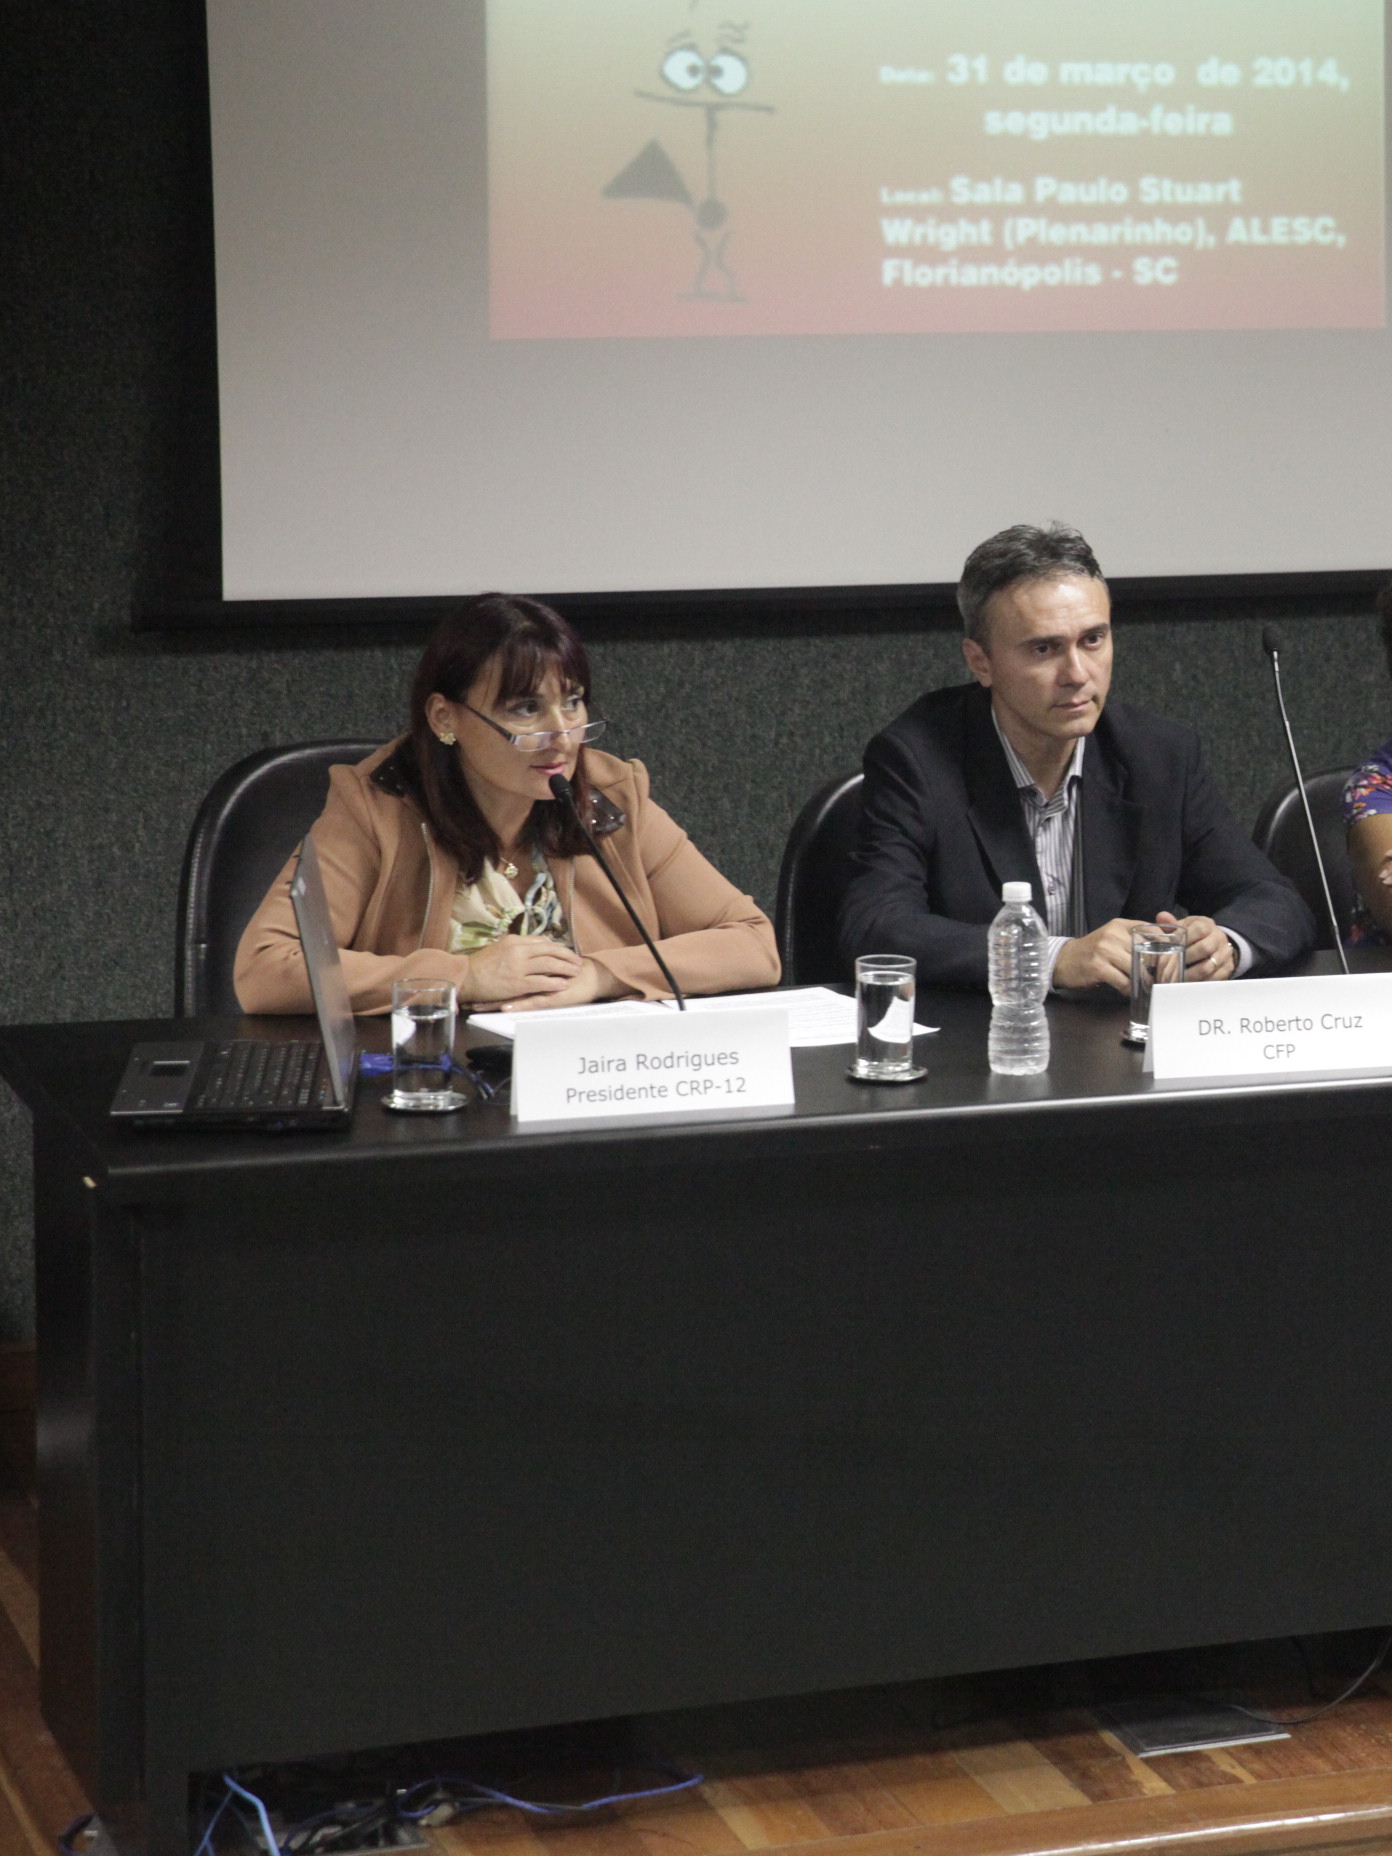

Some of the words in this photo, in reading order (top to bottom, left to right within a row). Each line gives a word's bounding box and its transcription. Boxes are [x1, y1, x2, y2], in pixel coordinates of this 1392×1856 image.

[947, 53, 989, 84] 31
[1004, 55, 1047, 85] de
[1059, 60, 1175, 92] março
[1198, 58, 1240, 86] de
[1253, 57, 1350, 91] 2014,
[983, 104, 1233, 140] segunda-feira
[949, 176, 1024, 204] Sala
[1035, 177, 1129, 204] Paulo
[1139, 177, 1242, 204] Stuart
[880, 218, 992, 251] Wright
[1004, 218, 1215, 249] (Plenarinho),
[1226, 217, 1346, 248] ALESC,
[881, 258, 1101, 290] Florianópolis
[1132, 257, 1179, 284] SC
[1199, 1019, 1231, 1035] DR.
[1240, 1016, 1313, 1033] Roberto
[1321, 1014, 1362, 1030] Cruz
[578, 1056, 626, 1074] Jaira
[636, 1051, 740, 1072] Rodrigues
[1263, 1044, 1295, 1059] CFP
[566, 1083, 668, 1104] Presidente
[676, 1077, 746, 1097] CRP-12
